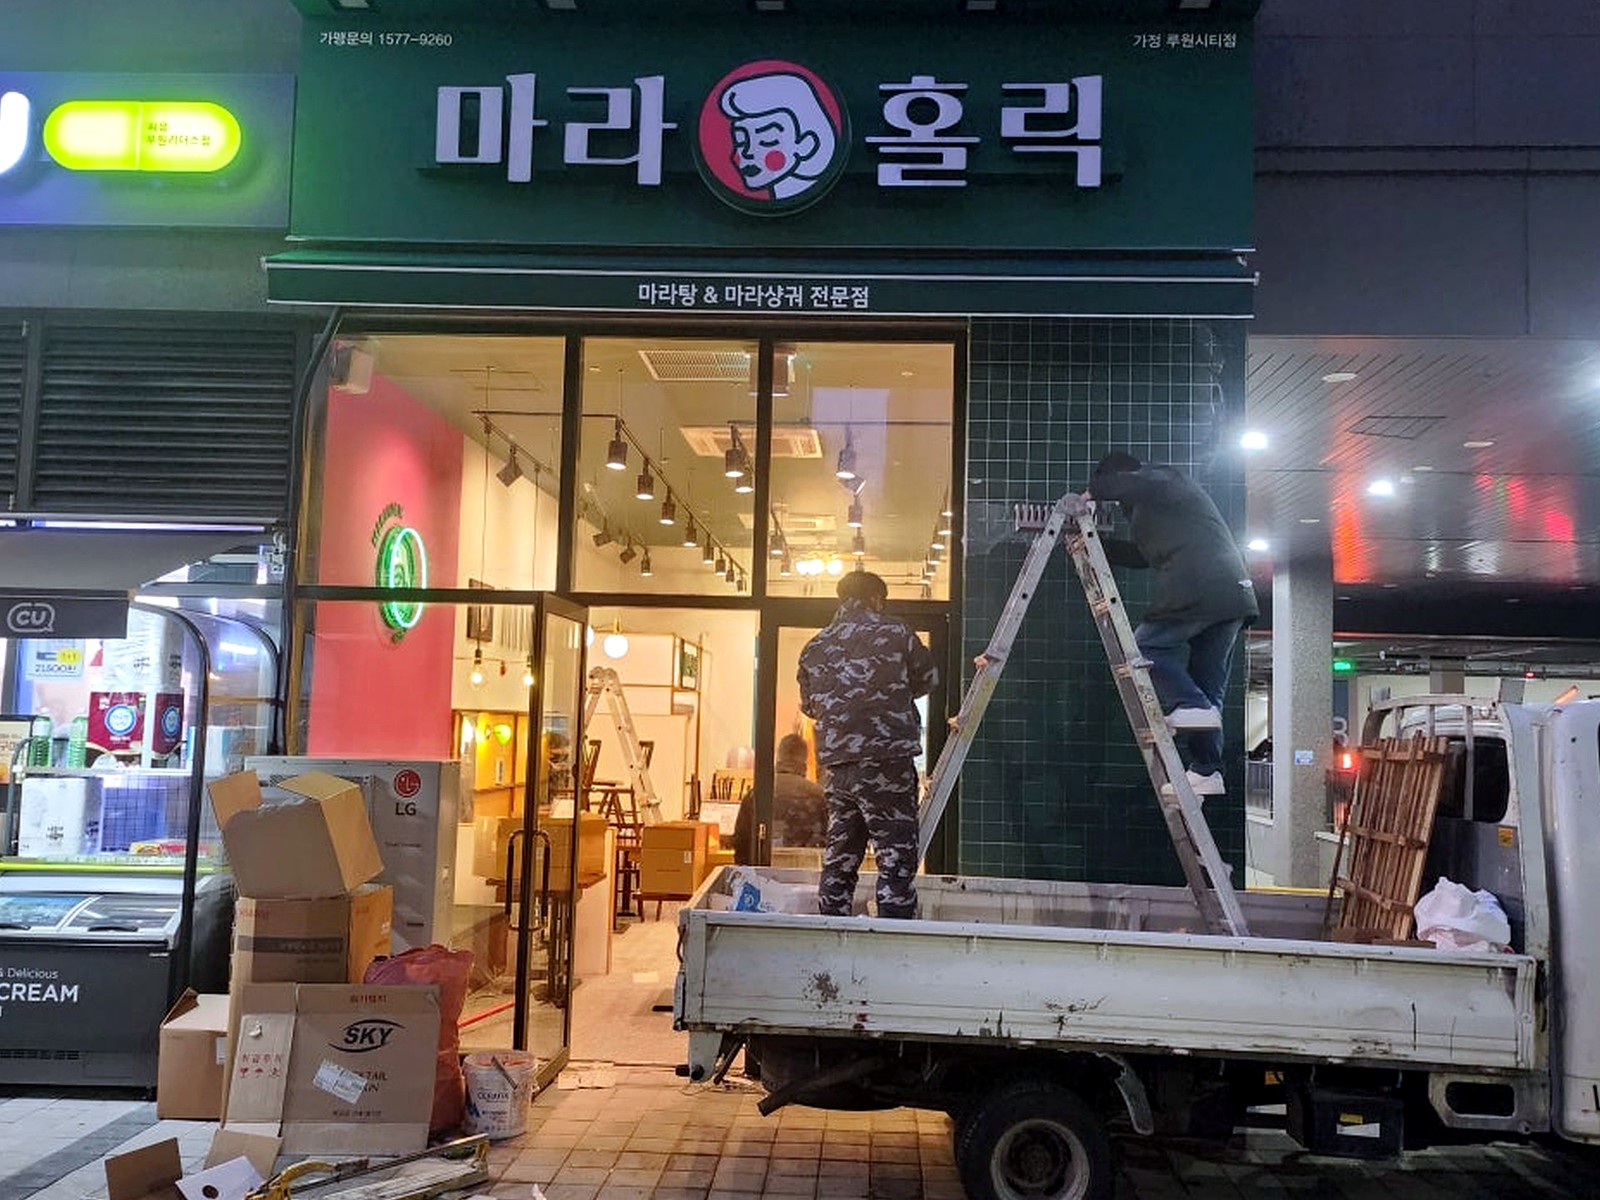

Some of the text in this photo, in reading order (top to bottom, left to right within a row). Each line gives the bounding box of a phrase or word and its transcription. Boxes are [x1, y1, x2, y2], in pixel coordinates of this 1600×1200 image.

[319, 31, 453, 47] 가맹문의 1577-9260
[1132, 32, 1162, 49] 가정
[436, 73, 1103, 188] 마라 홀릭
[638, 283, 870, 309] 마라탕 & 마라샹궈 전문점
[16, 610, 47, 626] CU
[395, 802, 417, 816] LG
[7, 967, 59, 980] Delicious
[0, 982, 79, 1004] CREAM
[344, 1027, 393, 1045] SKY
